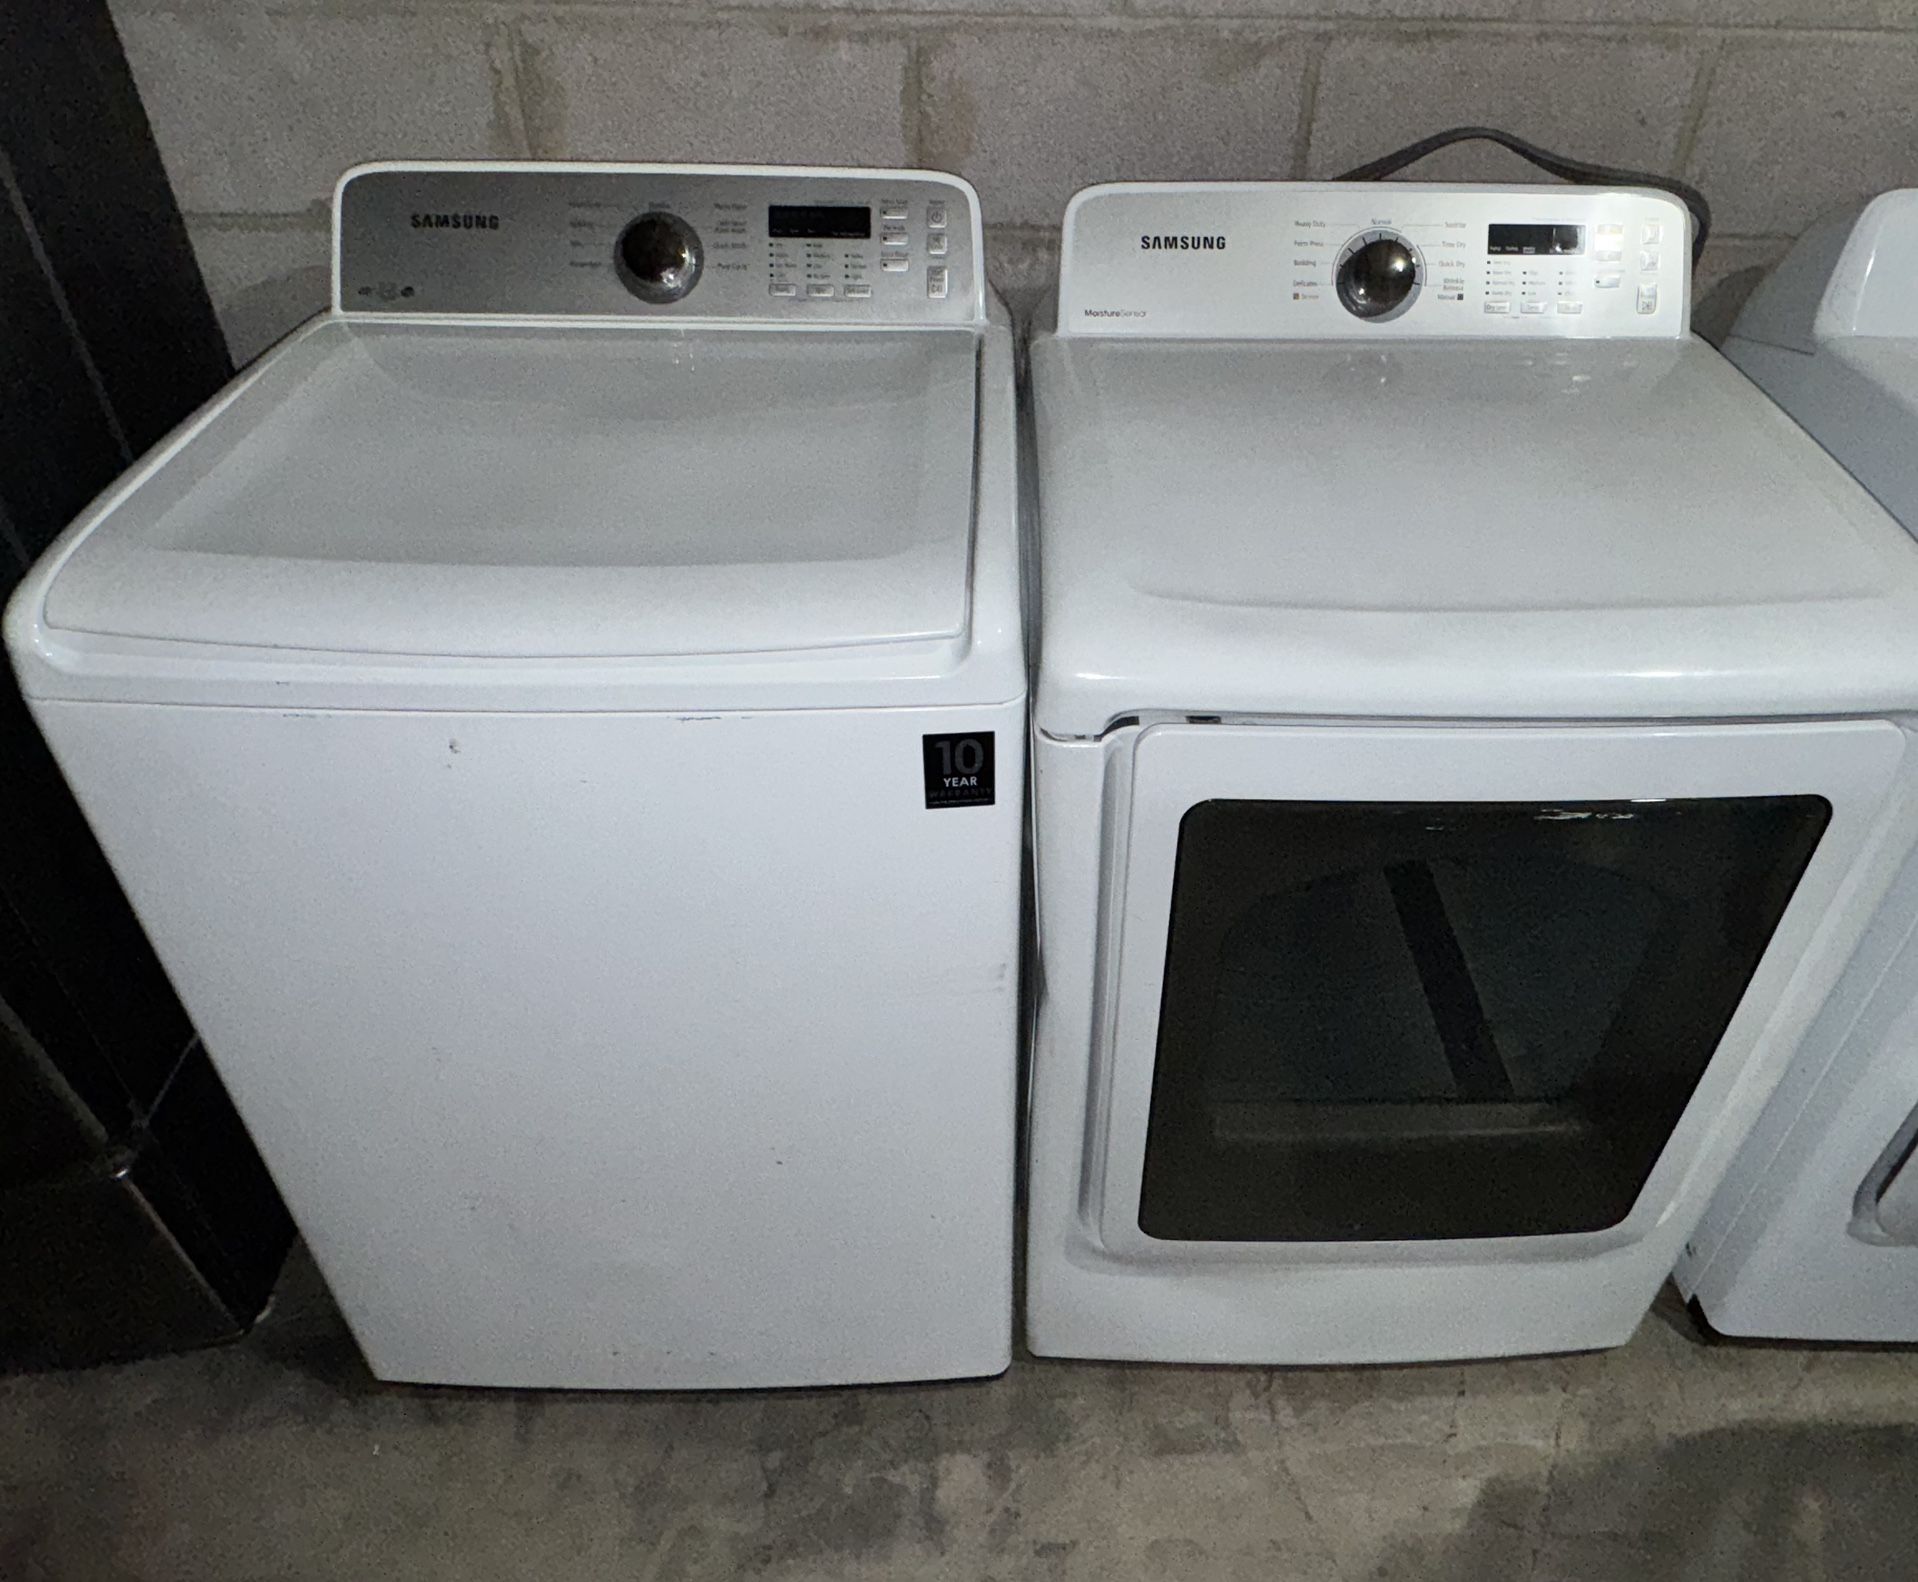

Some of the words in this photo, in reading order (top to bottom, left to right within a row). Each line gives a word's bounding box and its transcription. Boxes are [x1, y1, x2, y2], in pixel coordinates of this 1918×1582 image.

[410, 213, 499, 230] SAMSUNG
[1141, 235, 1226, 250] SAMSUNG
[935, 738, 984, 775] 10
[943, 776, 978, 788] YEAR
